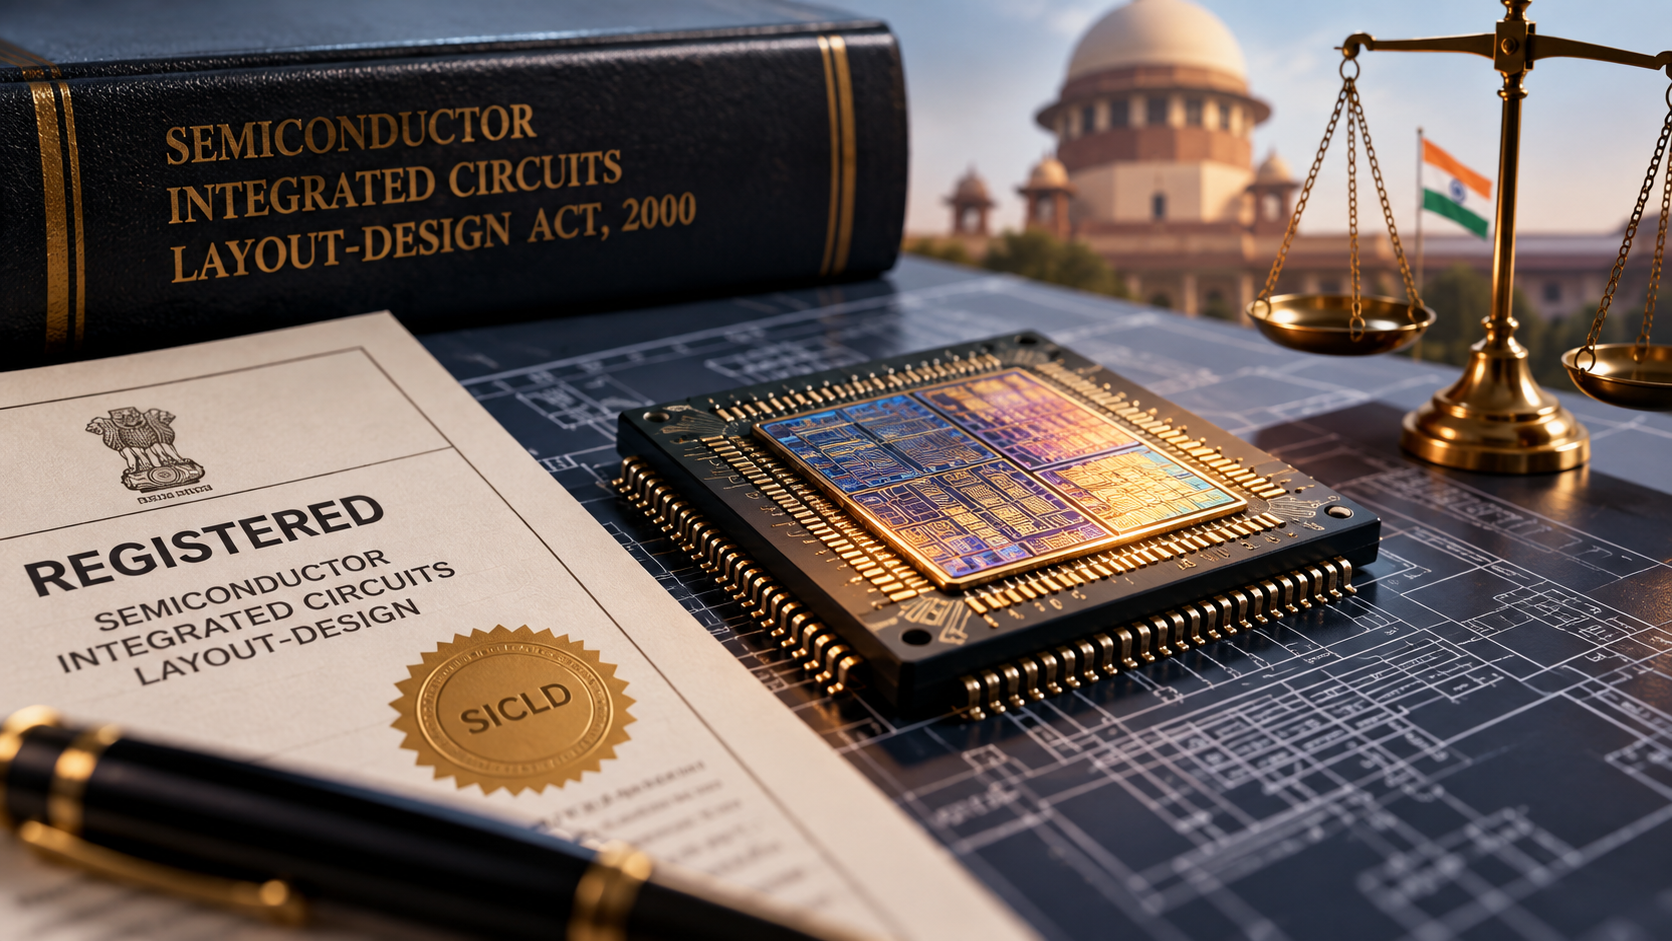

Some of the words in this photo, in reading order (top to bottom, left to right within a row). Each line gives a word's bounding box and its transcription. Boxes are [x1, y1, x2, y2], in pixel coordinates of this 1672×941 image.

[166, 103, 539, 166] SEMICONDUCTOR
[167, 165, 438, 225] INTEGRATED
[448, 149, 623, 198] CIRCUITS
[170, 215, 512, 284] LAYOUT-DESIGN
[527, 202, 610, 243] ACT,
[621, 191, 697, 232] 2000
[24, 494, 385, 598] REGISTERED
[56, 601, 294, 674] INTEGRATED
[302, 561, 456, 612] CIRCUITS
[93, 548, 392, 632] SEMICONDUCTOR
[133, 597, 421, 687] LAYOUT-DESIGN
[460, 682, 573, 735] SICLD
